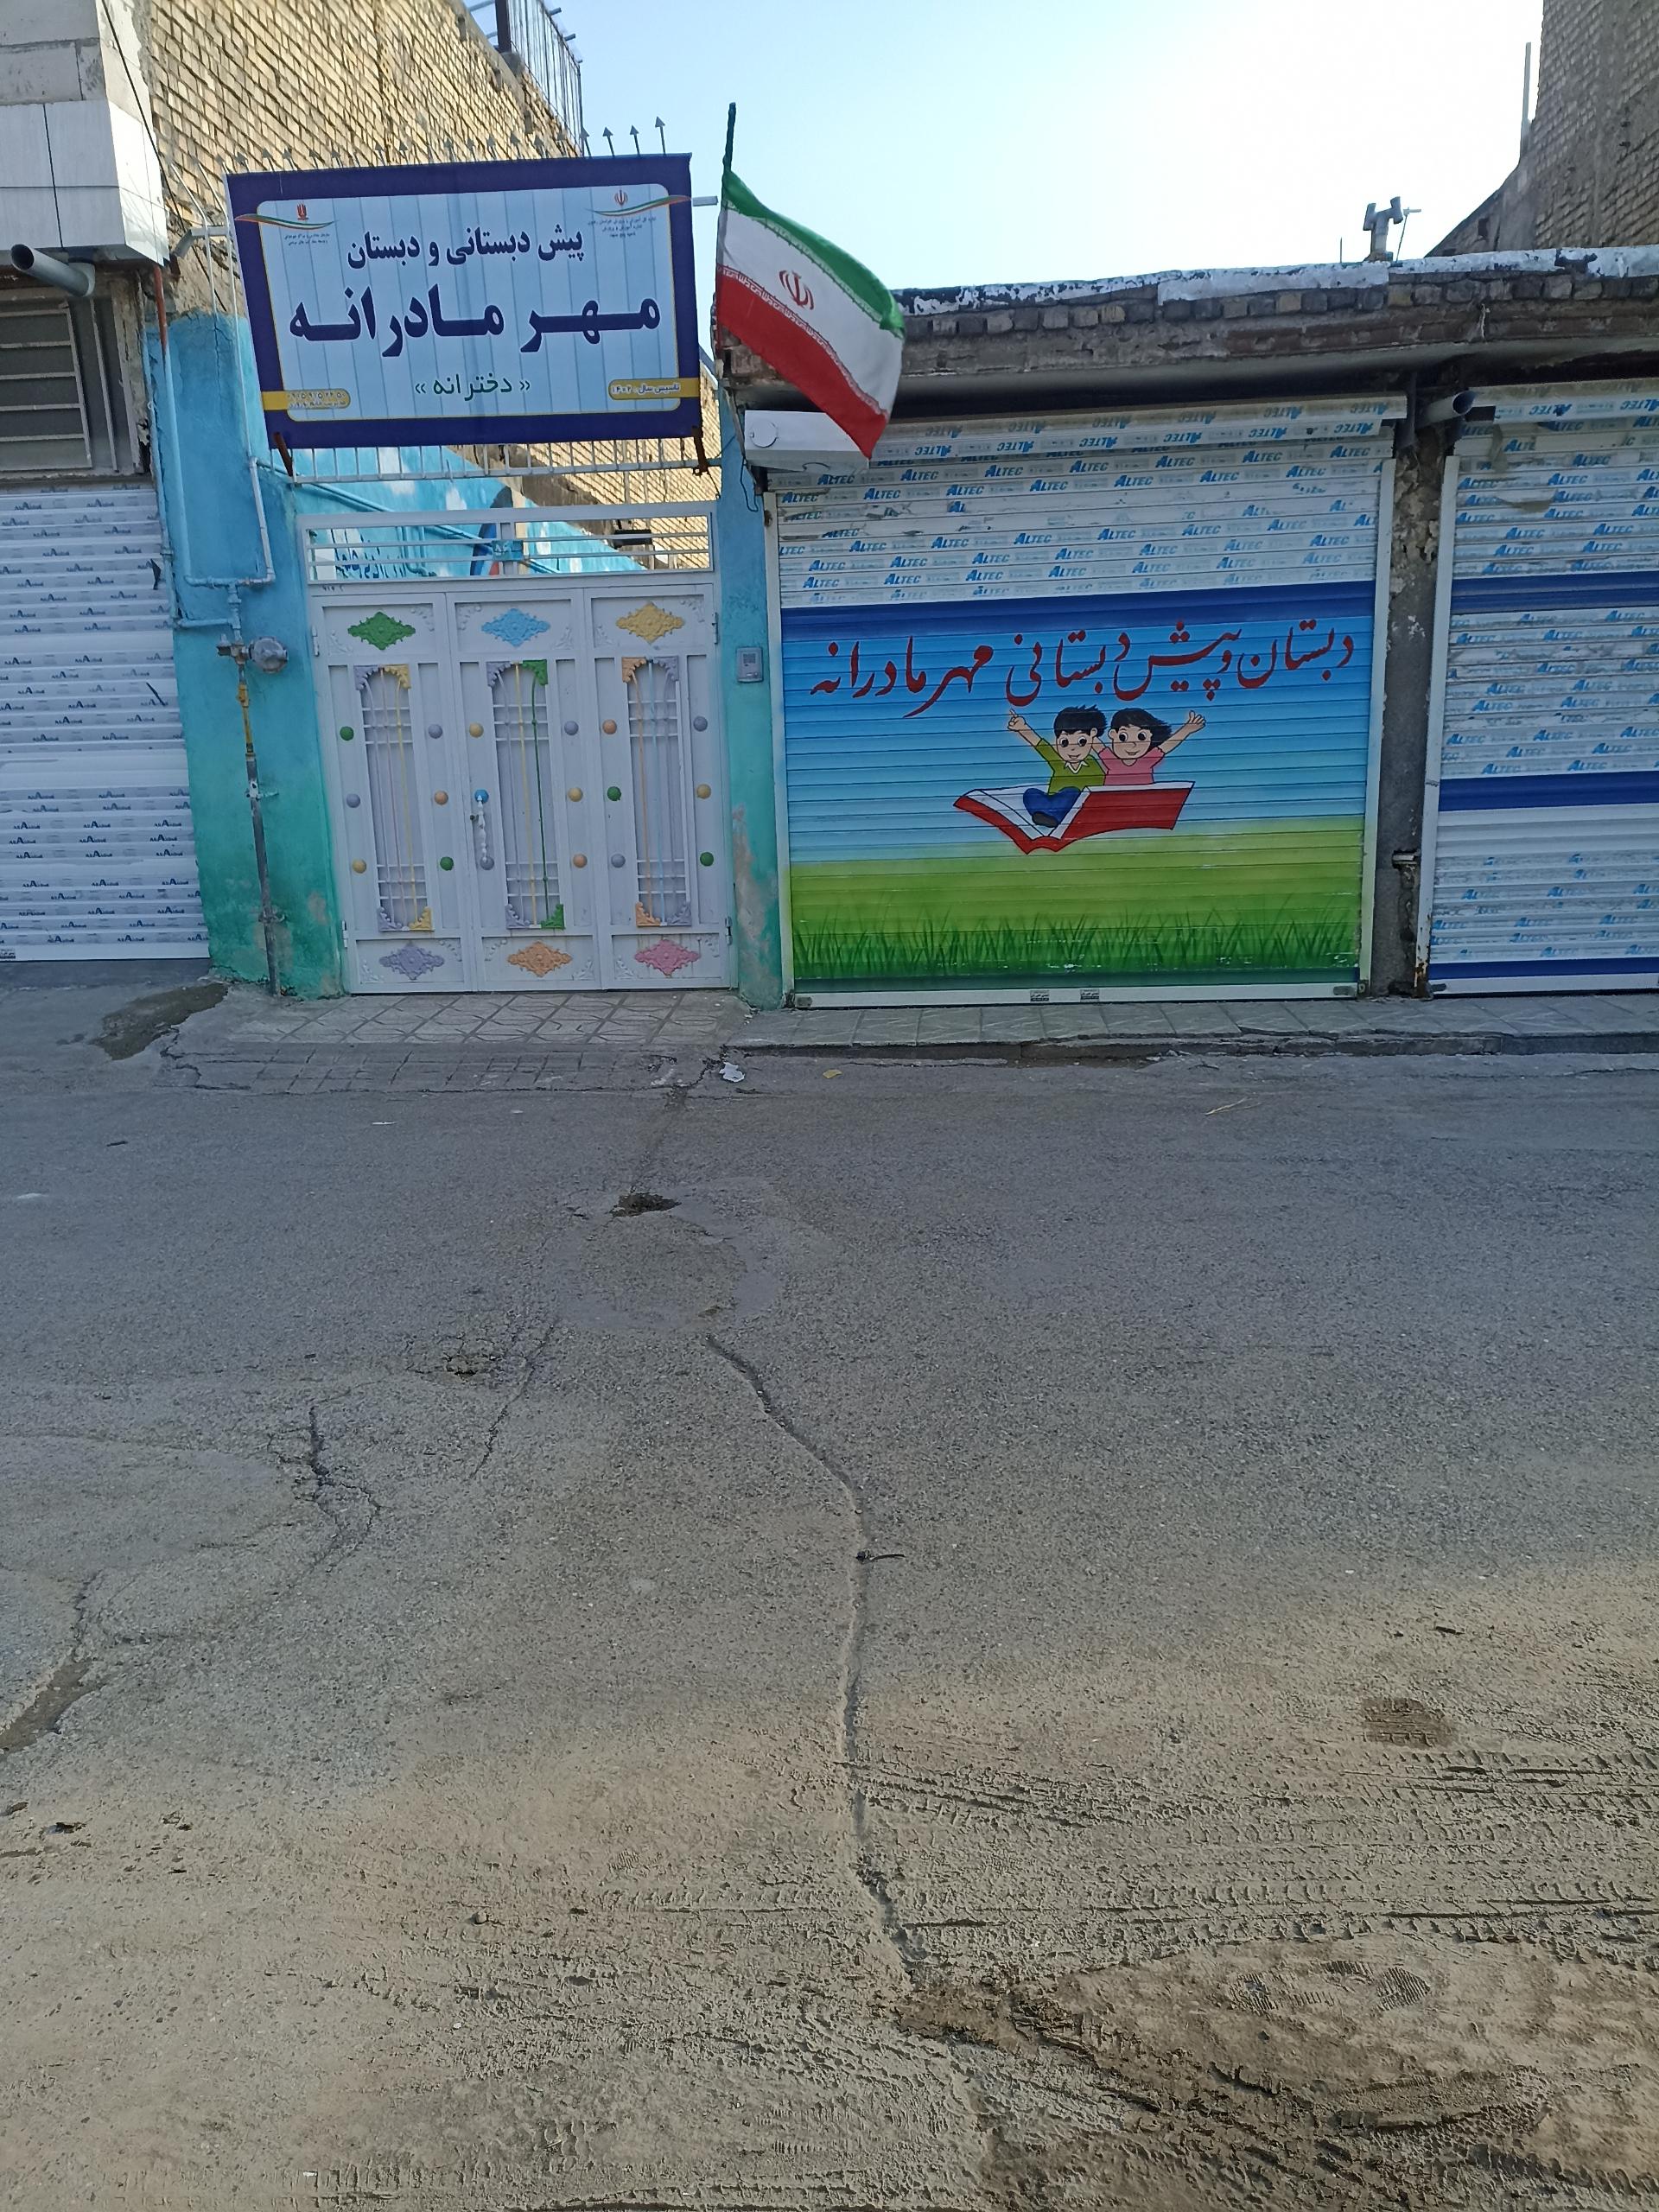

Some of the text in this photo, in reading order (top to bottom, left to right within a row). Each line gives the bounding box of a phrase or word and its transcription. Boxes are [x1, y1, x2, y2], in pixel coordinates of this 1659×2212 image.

[347, 224, 584, 269] پیش دبستانی و دبستان
[289, 283, 661, 357] مهر مادرانه
[817, 445, 1370, 485] ALTEC ALTEC ALTEC ALTEC ALTEC ALTEC ALTEC
[1548, 474, 1588, 486] ALTEC
[782, 466, 1325, 503] ALTEC ALTEC ALTEC ALTEC ALTEC ALTEC ALTEC
[849, 541, 887, 552] ALTEC
[931, 537, 969, 549] ALTEC
[1014, 533, 1052, 544] ALTEC
[1097, 528, 1135, 540] ALTEC
[1182, 524, 1221, 536] ALTEC
[1267, 519, 1306, 531] ALTEC
[1494, 540, 1623, 557] ALTEC ALTEC
[1506, 523, 1634, 539] ALTEC ALTEC
[803, 552, 1341, 588] ALTEC ALTEC ALTEC ALTEC ALTEC ALTEC ALTEC
[809, 534, 1349, 571] ALTEC ALTEC ALTEC ALTEC ALTEC ALTEC ALTEC
[810, 619, 1355, 718] دبستان و پیش دبستانی مهر مادرانه
